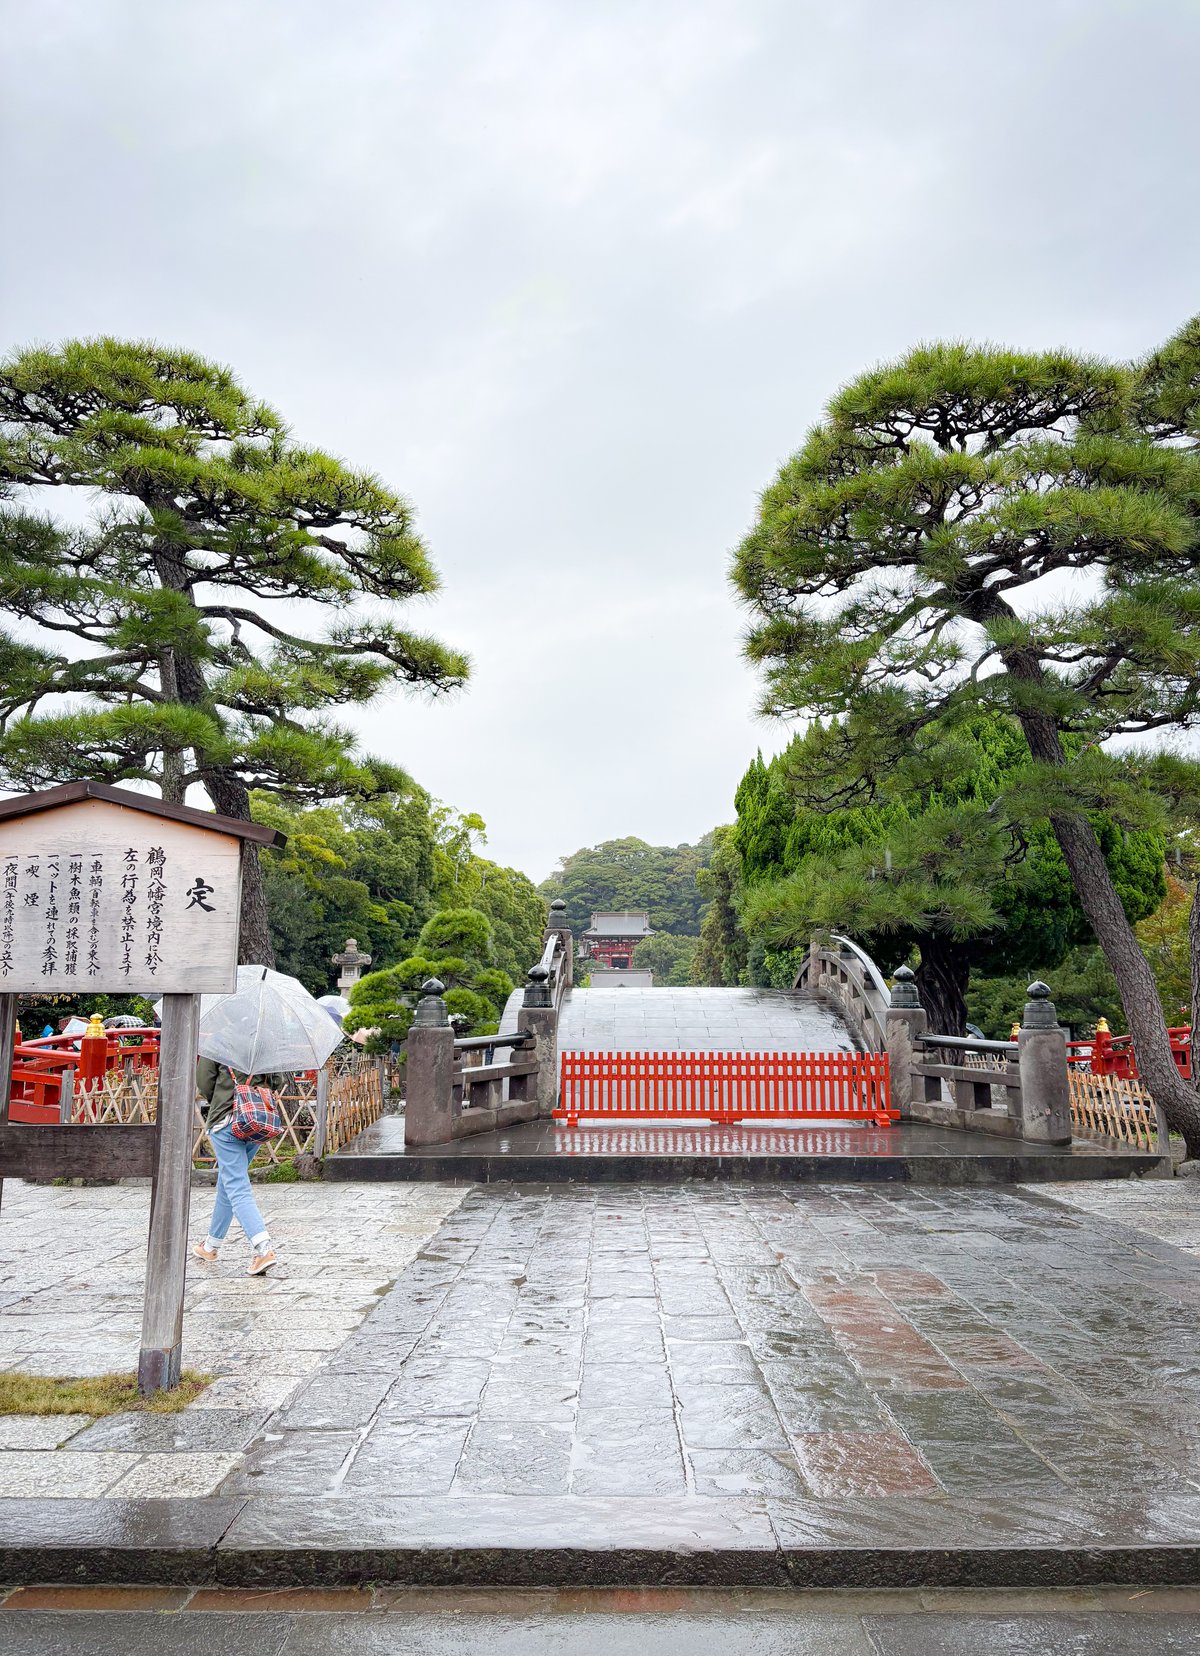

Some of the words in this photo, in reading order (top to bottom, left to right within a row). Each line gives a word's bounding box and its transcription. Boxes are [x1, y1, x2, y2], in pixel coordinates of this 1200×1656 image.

[119, 847, 139, 976] 左の行為を禁止します
[145, 846, 167, 975] 鶴岡八幡宮境内に於て
[185, 877, 216, 912] 定
